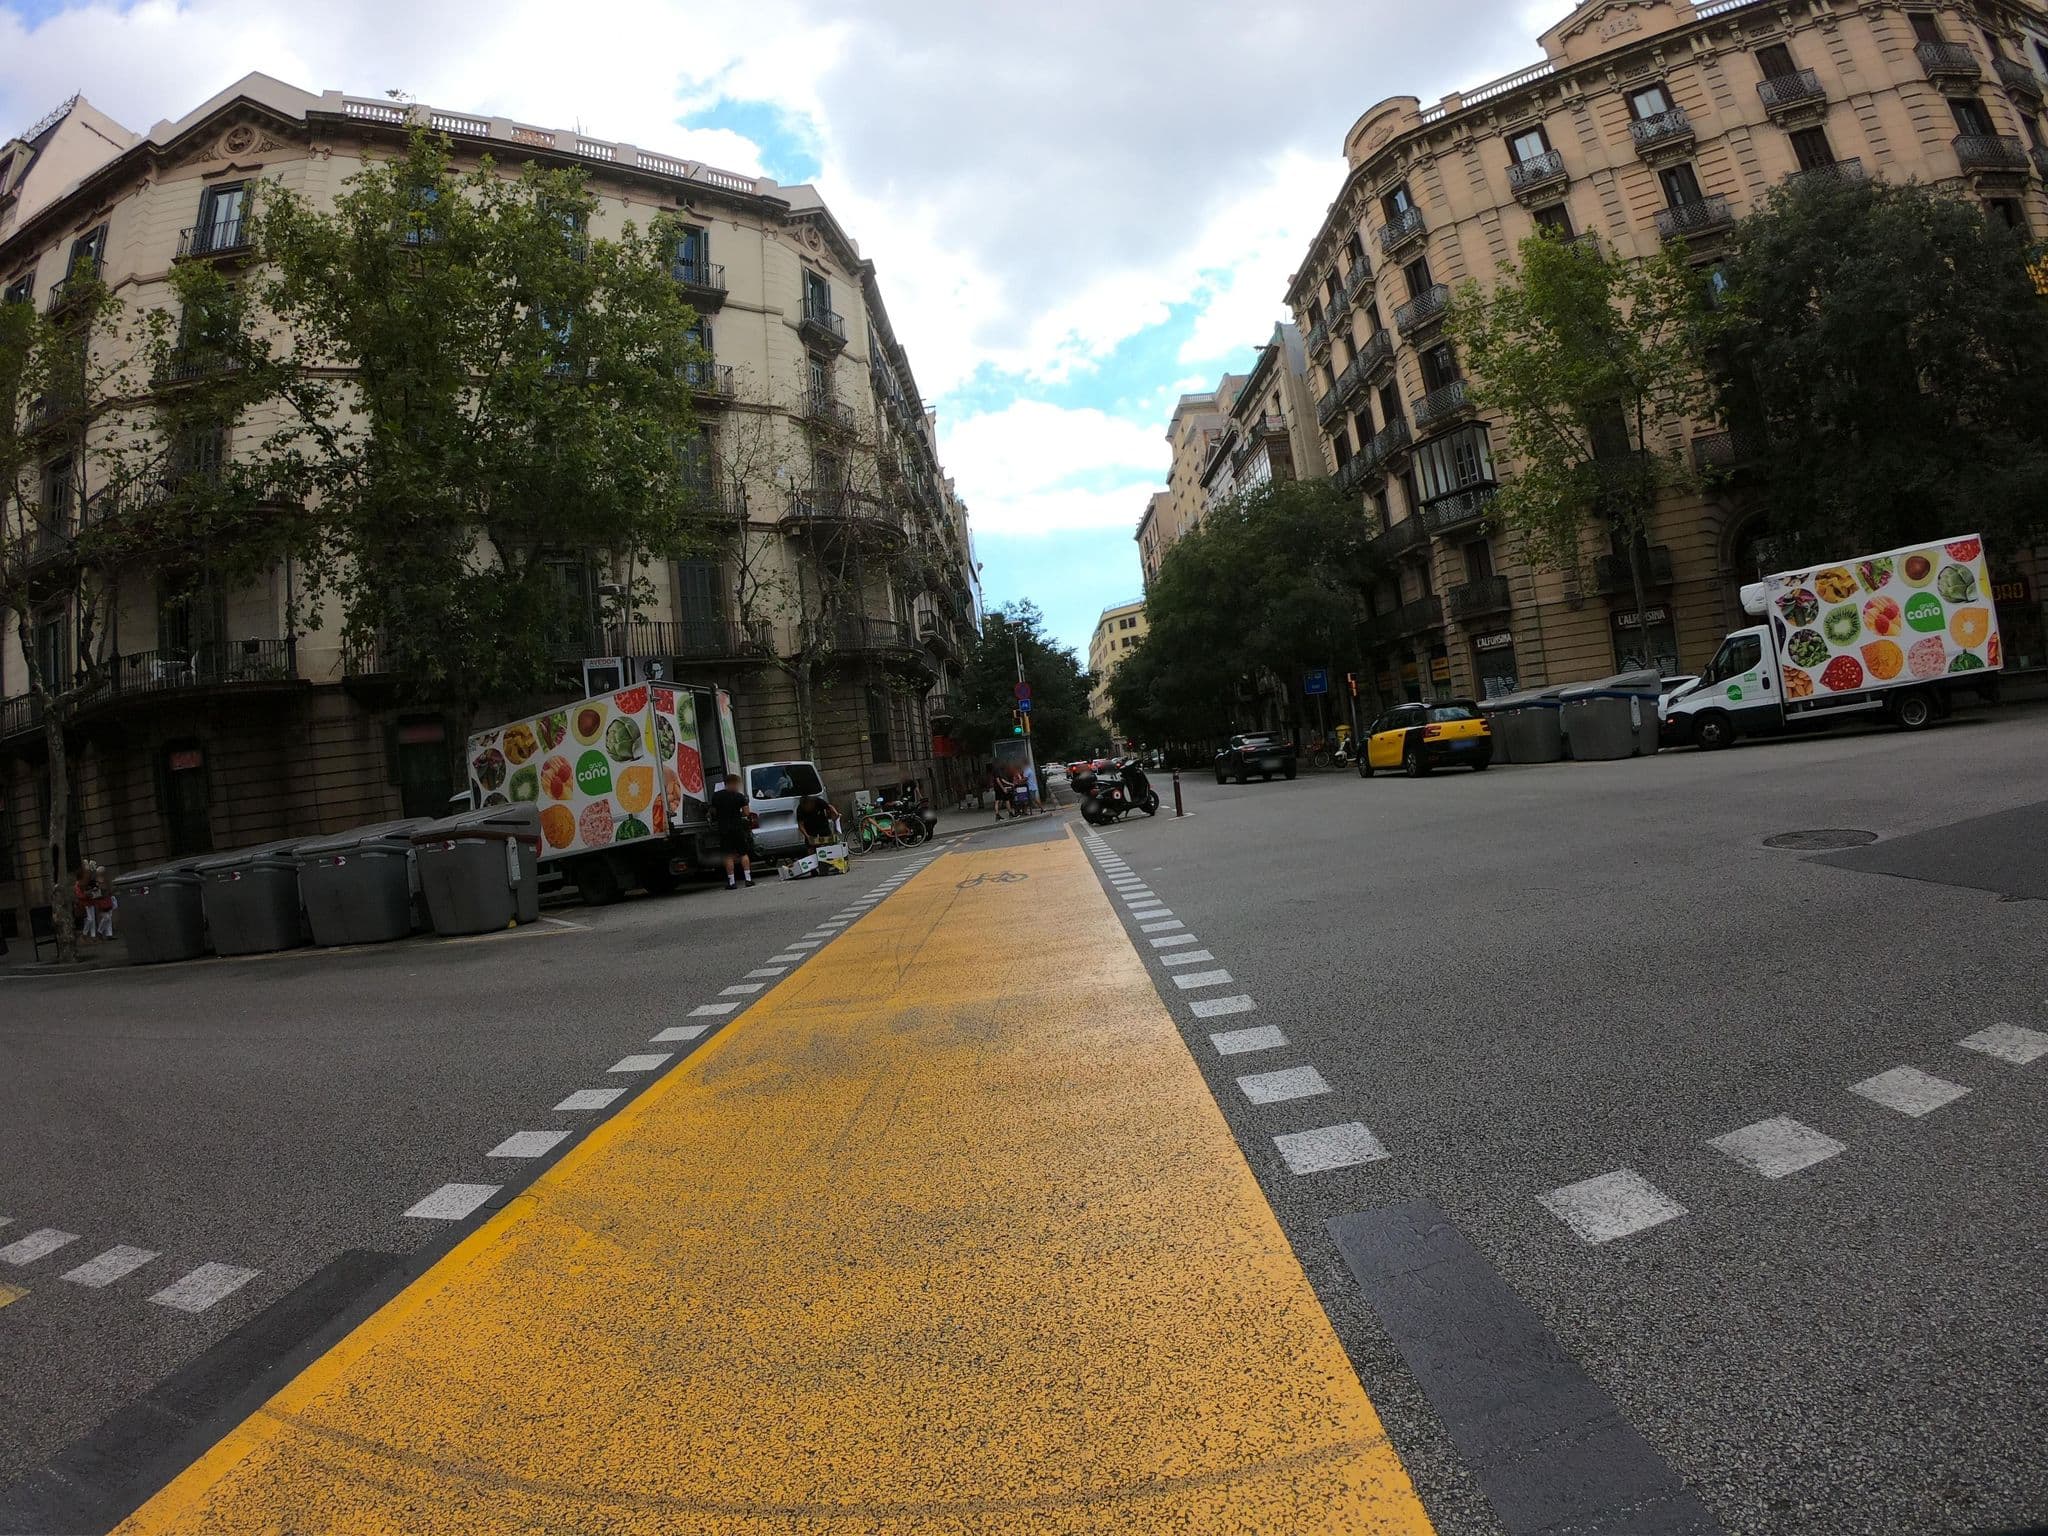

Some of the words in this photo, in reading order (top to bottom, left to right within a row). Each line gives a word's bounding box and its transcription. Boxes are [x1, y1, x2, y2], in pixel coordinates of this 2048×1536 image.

[1618, 609, 1666, 626] L'ALFSINA
[1907, 606, 1941, 620] cano
[590, 658, 616, 666] AVEDON
[578, 766, 608, 782] cano
